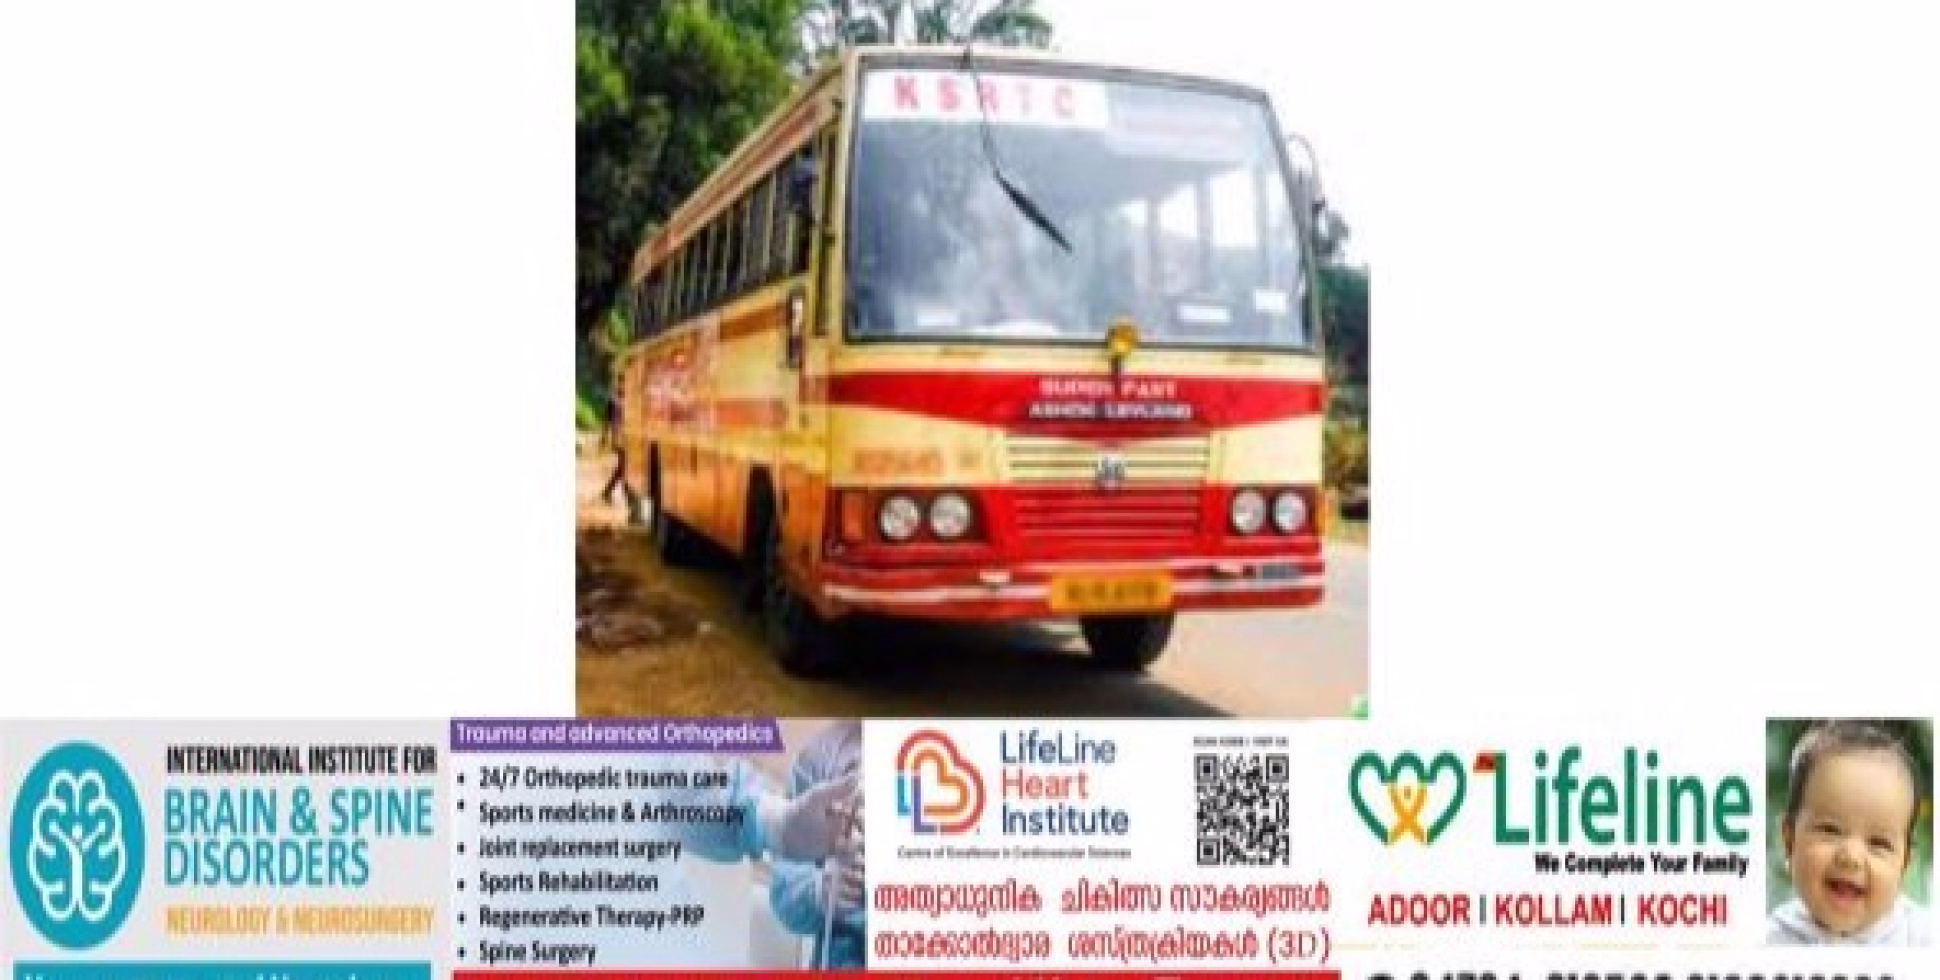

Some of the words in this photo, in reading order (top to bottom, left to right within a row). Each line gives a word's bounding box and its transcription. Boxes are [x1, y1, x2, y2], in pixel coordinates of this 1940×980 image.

[457, 723, 527, 744] Trauma
[532, 723, 567, 744] and
[569, 723, 658, 744] advanced
[663, 722, 773, 748] Orthopedics
[1001, 730, 1116, 764] LifeLine
[166, 745, 302, 774] INTERNATIONAL
[309, 745, 396, 774] INSTITUTE
[404, 745, 437, 774] FOR
[480, 767, 519, 790] 24/7
[524, 766, 620, 792] Orthopedic
[625, 768, 690, 788] trauma
[696, 770, 728, 788] care
[1002, 770, 1088, 800] Heart
[1495, 746, 1752, 845] Lifeline
[164, 788, 277, 835] BRAIN
[290, 786, 317, 836] &
[330, 788, 433, 835] SPINE
[479, 802, 534, 826] Sports
[538, 803, 616, 821] medicine
[621, 803, 636, 821] &
[640, 802, 745, 827] Arthroscopy
[1002, 803, 1130, 835] Institute
[164, 840, 369, 886] DISORDERS
[479, 838, 517, 858] Joint
[522, 838, 618, 862] replacement
[624, 840, 681, 862] surgery
[1535, 853, 1560, 873] We
[1564, 853, 1645, 876] Complete
[1650, 853, 1687, 873] Your
[1692, 853, 1749, 877] Family
[479, 872, 533, 895] Sports
[539, 870, 658, 892] Rehabilitation
[167, 906, 269, 934] NEUROLOGY
[295, 906, 434, 934] NEUROSURGERY
[480, 906, 590, 929] Regenerative
[1367, 894, 1470, 925] ADOOR
[1495, 894, 1612, 925] KOLLAM
[1638, 894, 1728, 925] KOCHI
[479, 940, 526, 964] Spine
[532, 940, 596, 966] Surgery
[1268, 926, 1331, 964] (3D)
